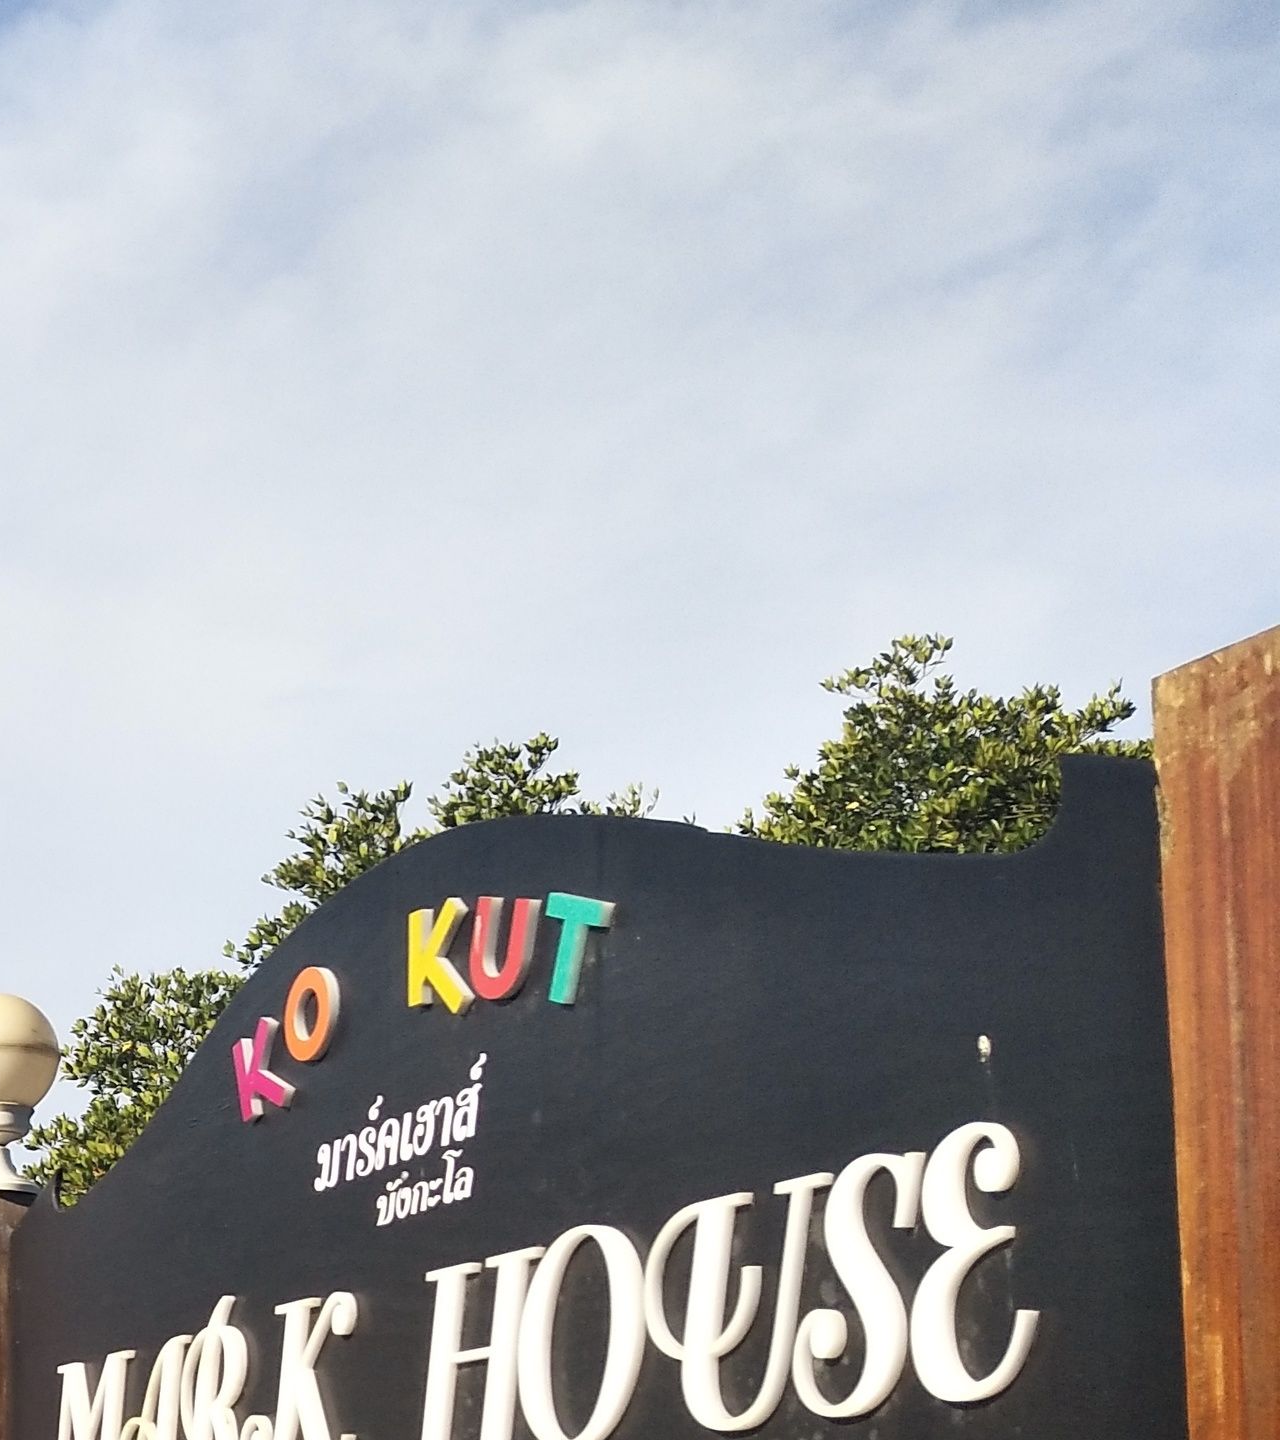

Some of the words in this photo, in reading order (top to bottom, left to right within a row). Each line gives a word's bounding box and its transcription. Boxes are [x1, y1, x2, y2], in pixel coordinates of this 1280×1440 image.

[232, 966, 340, 1122] KO
[408, 891, 615, 1014] KUT
[314, 1052, 487, 1192] มาร์คเฮาส์
[376, 1149, 474, 1226] บังกะโล
